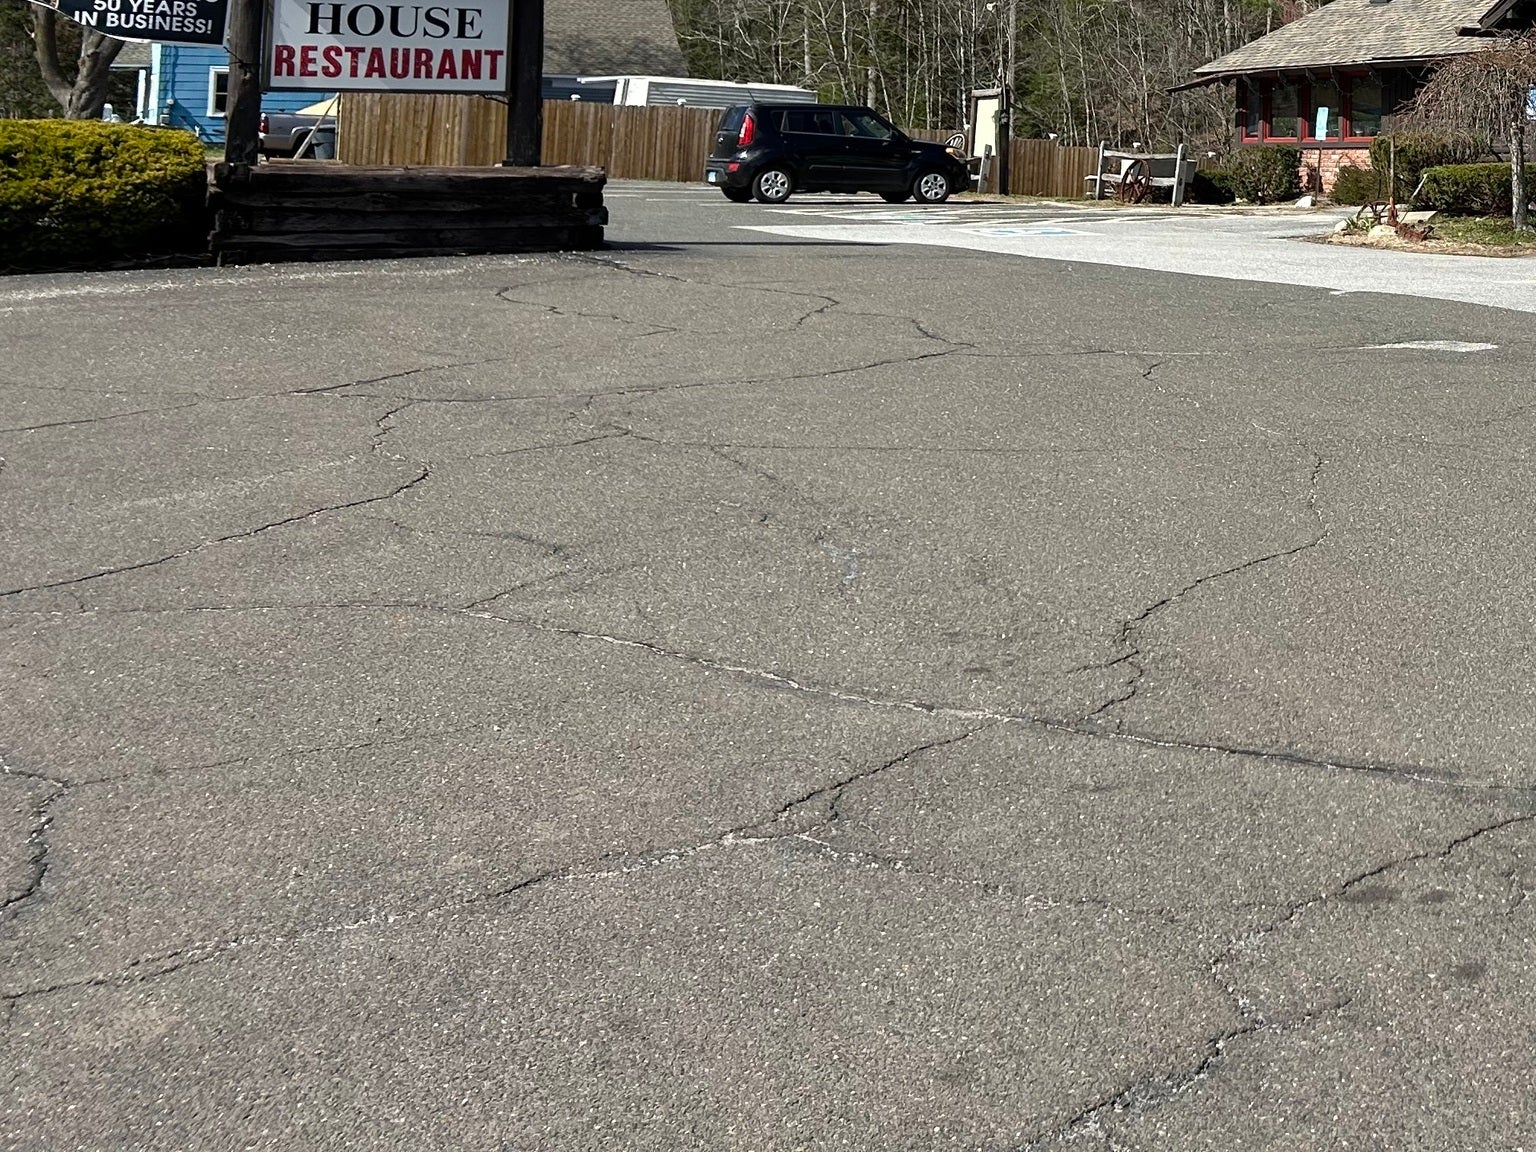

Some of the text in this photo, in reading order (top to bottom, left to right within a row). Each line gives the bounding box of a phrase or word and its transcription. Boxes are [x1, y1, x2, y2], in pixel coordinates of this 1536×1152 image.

[74, 10, 213, 34] IN BUSINESS!
[304, 1, 484, 39] HOUSE
[273, 44, 504, 80] RESTAURANT
